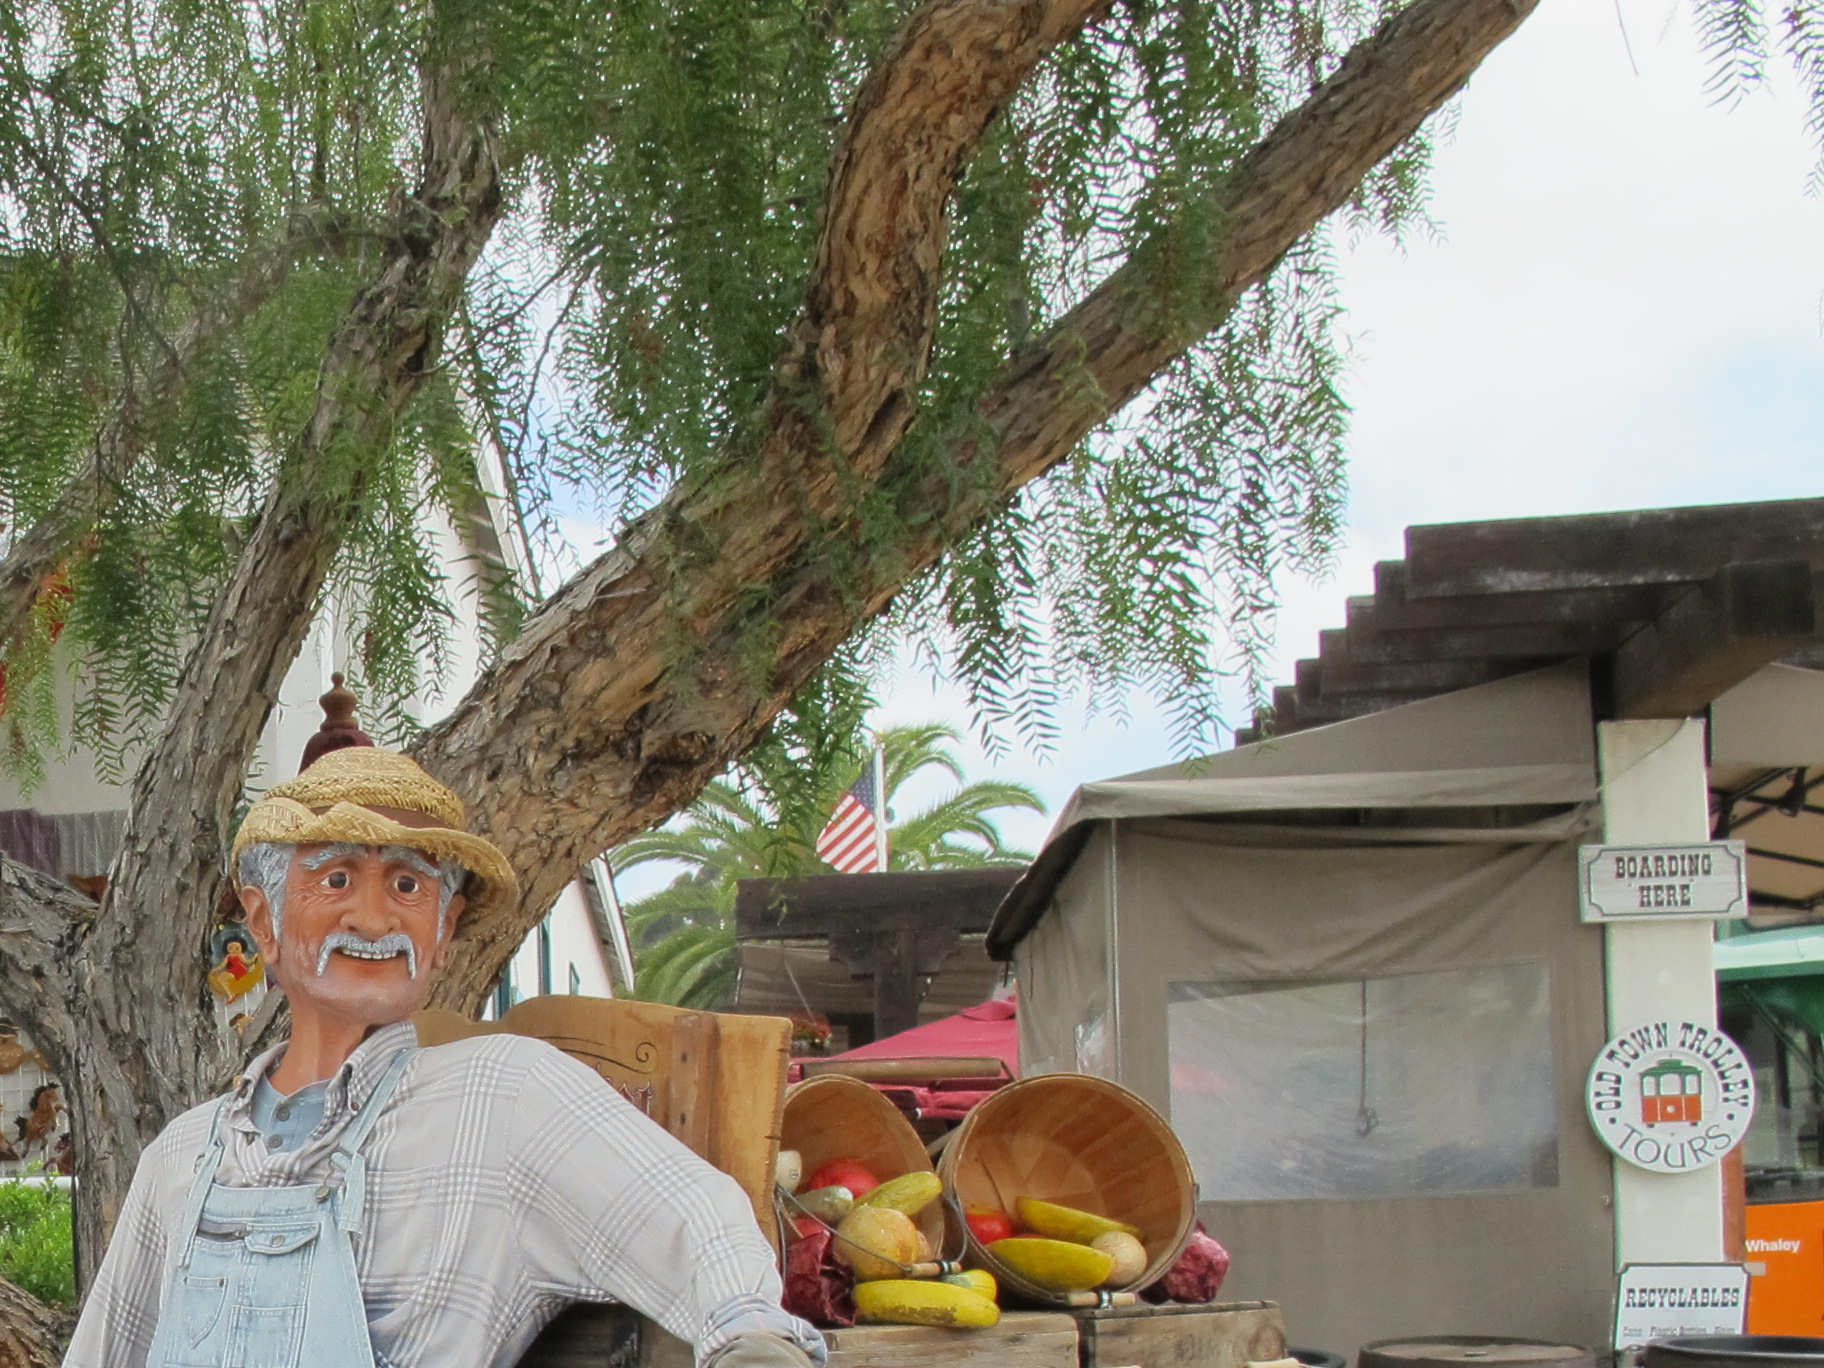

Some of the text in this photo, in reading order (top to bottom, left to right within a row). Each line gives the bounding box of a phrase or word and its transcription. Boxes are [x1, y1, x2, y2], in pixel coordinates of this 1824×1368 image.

[1614, 853, 1713, 880] BOARDING
[1638, 883, 1692, 908] HERE
[1594, 1022, 1750, 1112] OLD TOWN TROLLEY
[1618, 1123, 1733, 1169] TOURS
[1744, 1239, 1801, 1254] Whaley
[1625, 1287, 1740, 1308] RECYCLABLES
